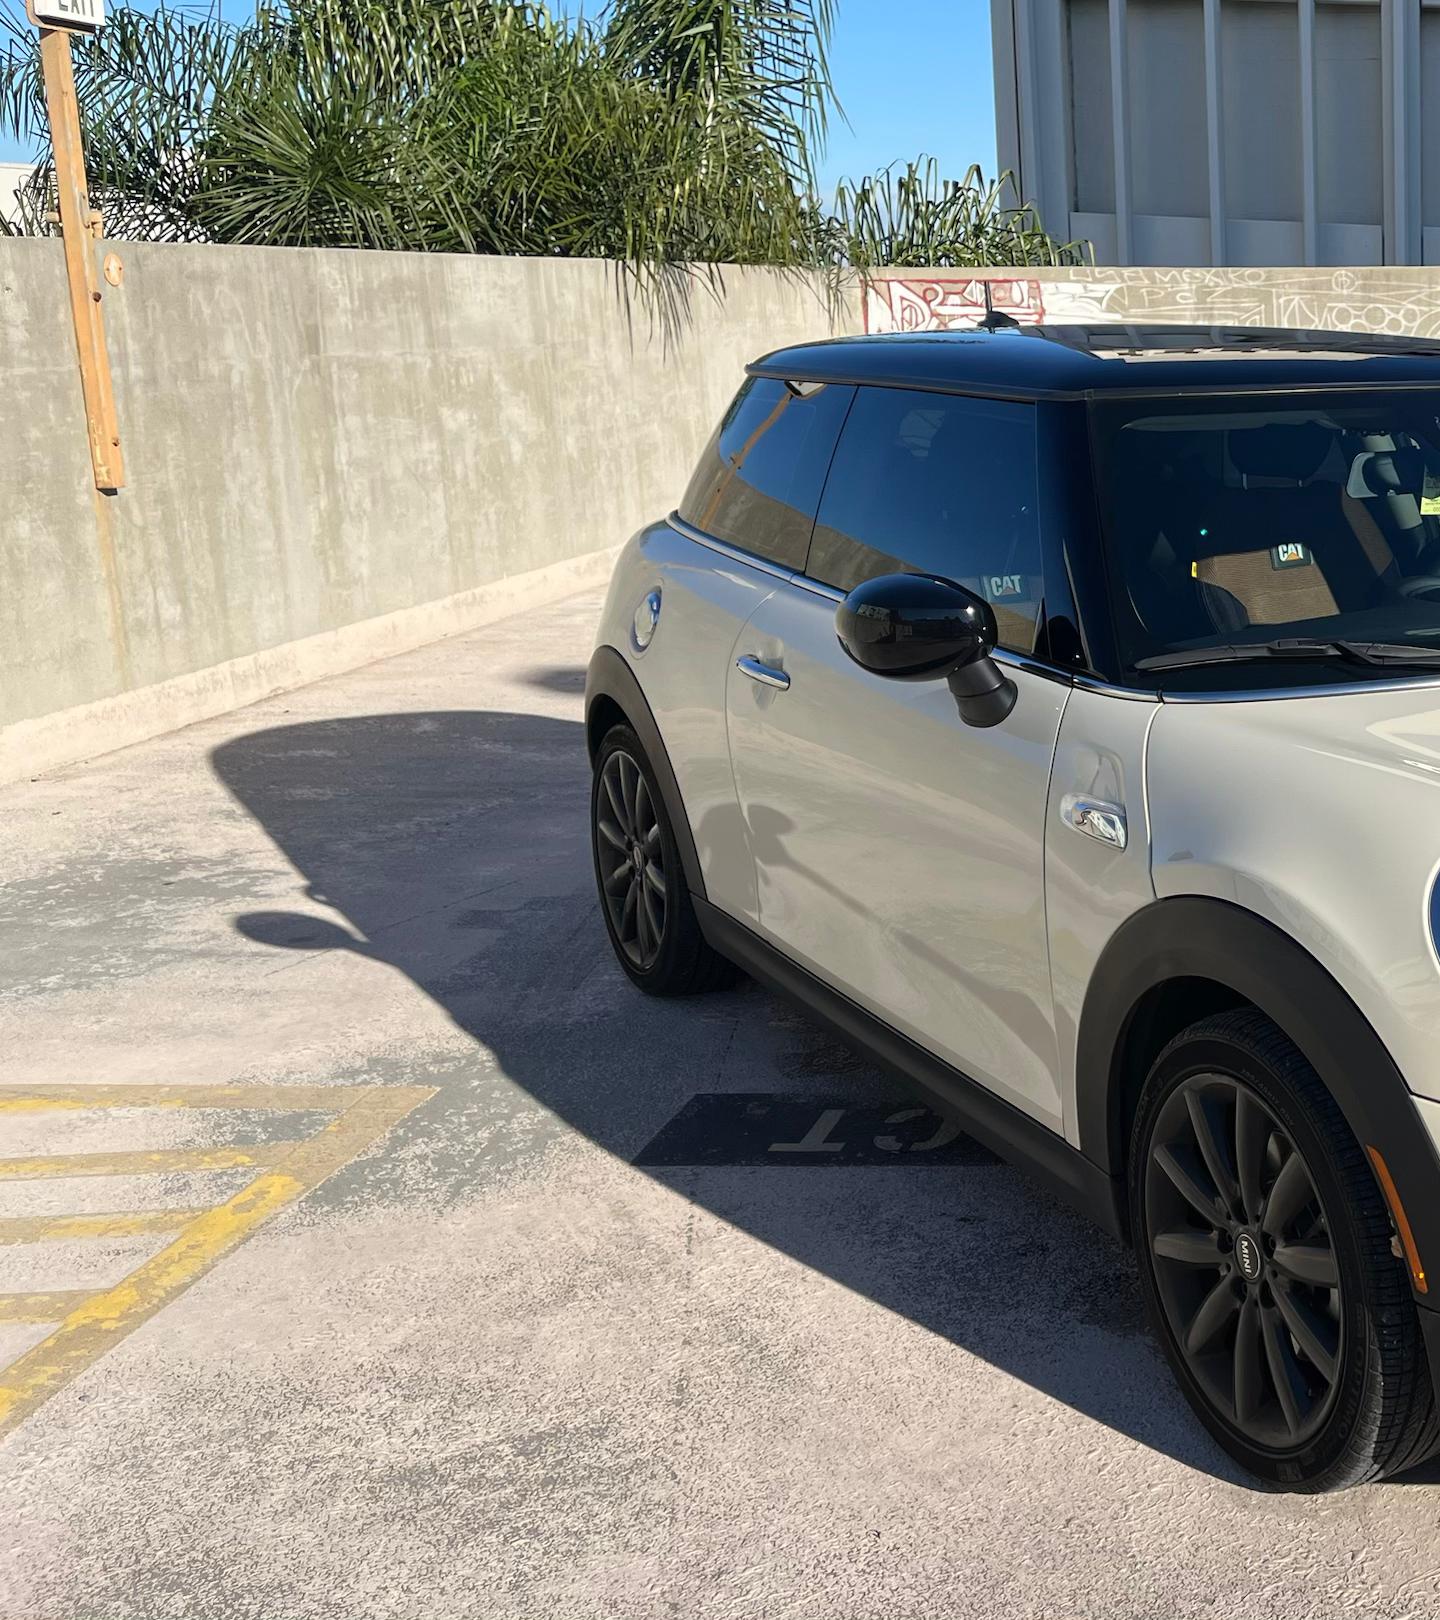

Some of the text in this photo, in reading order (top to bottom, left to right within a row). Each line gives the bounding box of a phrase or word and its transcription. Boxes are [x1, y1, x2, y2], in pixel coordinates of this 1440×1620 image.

[1278, 543, 1304, 562] CAT
[990, 574, 1021, 597] CAT
[1241, 1240, 1252, 1274] MINI
